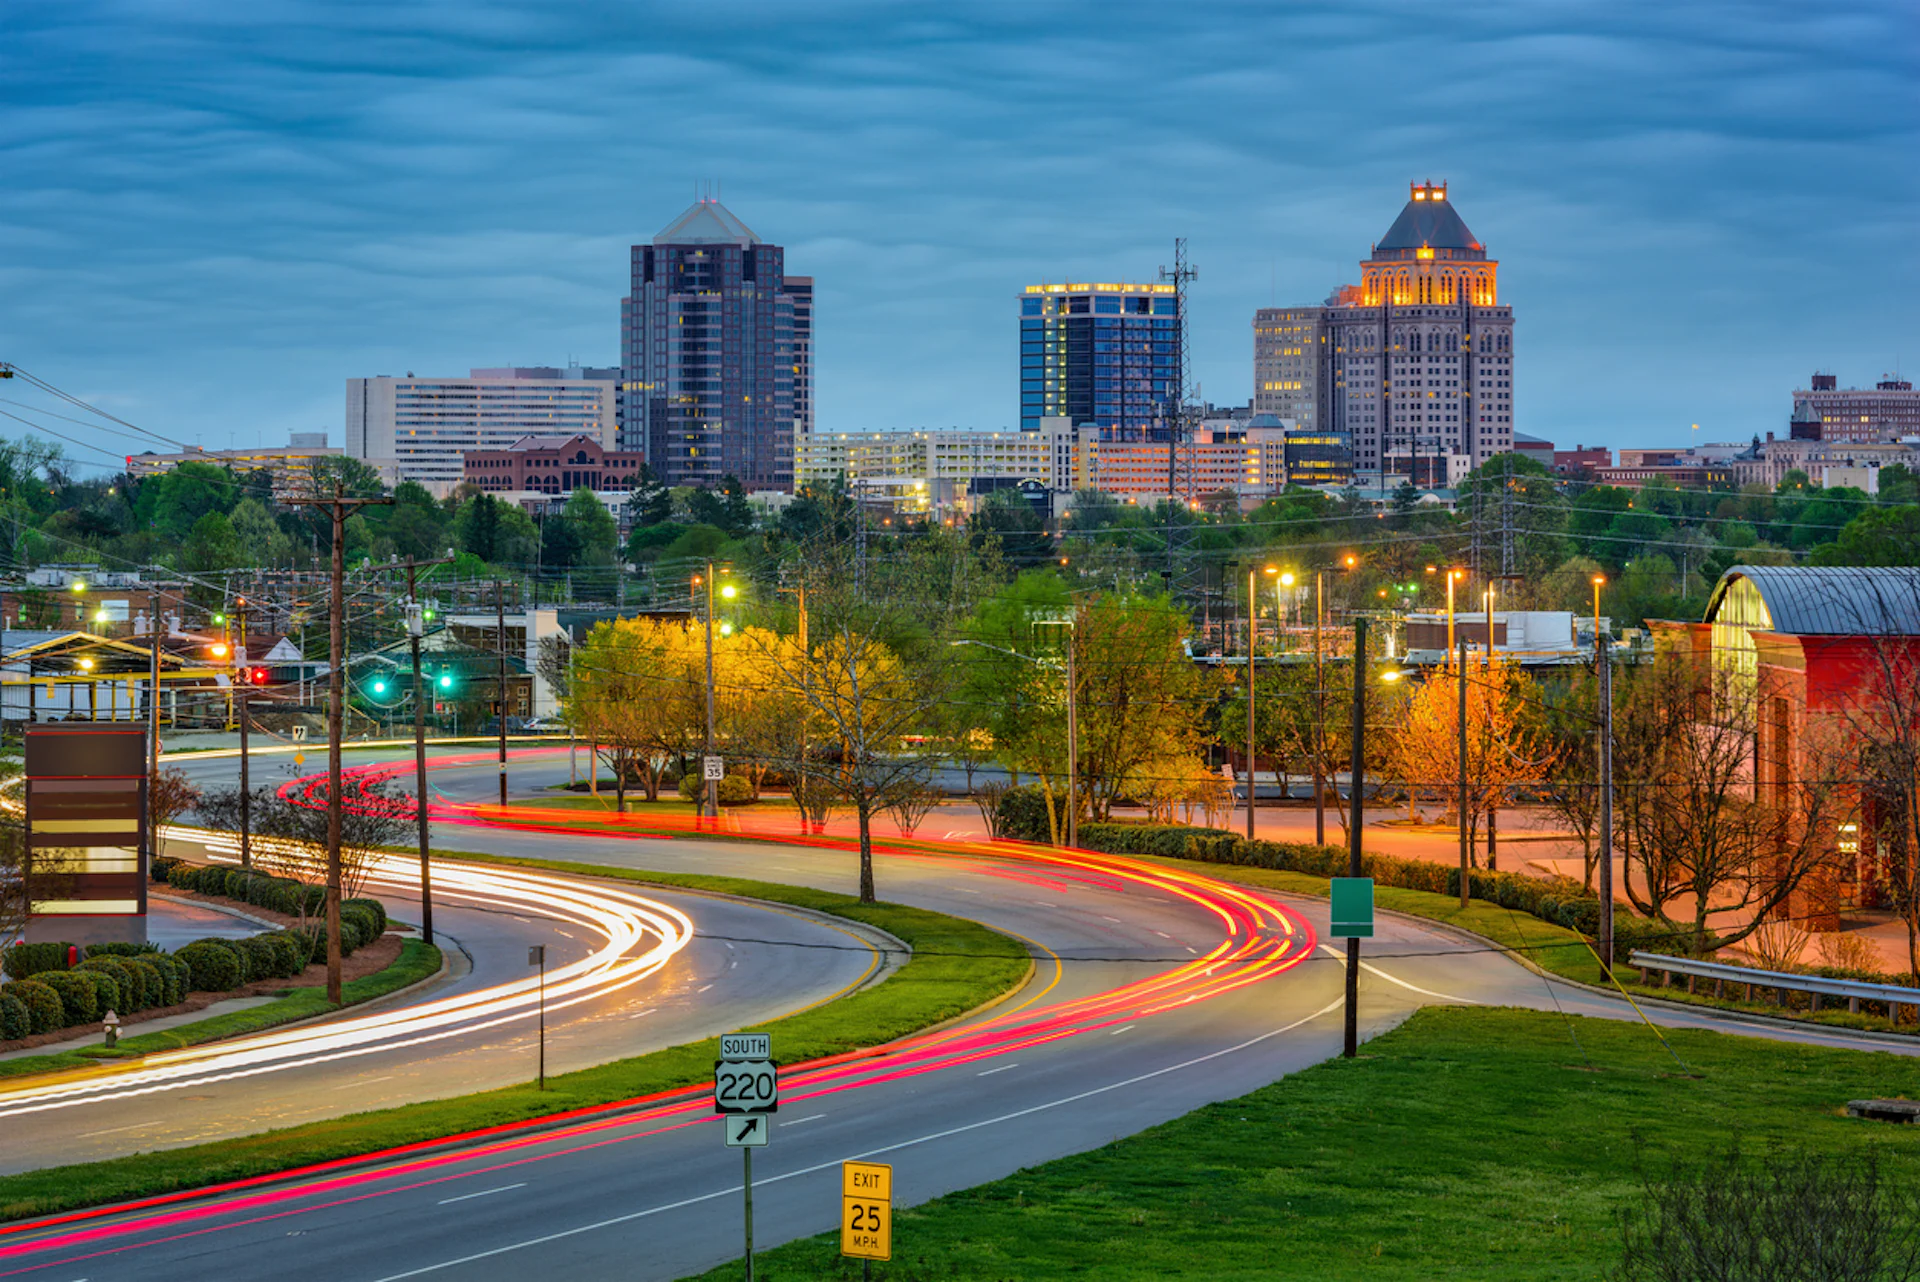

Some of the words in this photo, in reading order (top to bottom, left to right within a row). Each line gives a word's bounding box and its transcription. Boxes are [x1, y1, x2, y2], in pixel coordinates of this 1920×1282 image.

[708, 768, 722, 778] 35
[724, 1039, 766, 1054] SOUTH
[720, 1072, 773, 1100] 220
[854, 1172, 880, 1189] EXIT
[851, 1204, 881, 1232] 25
